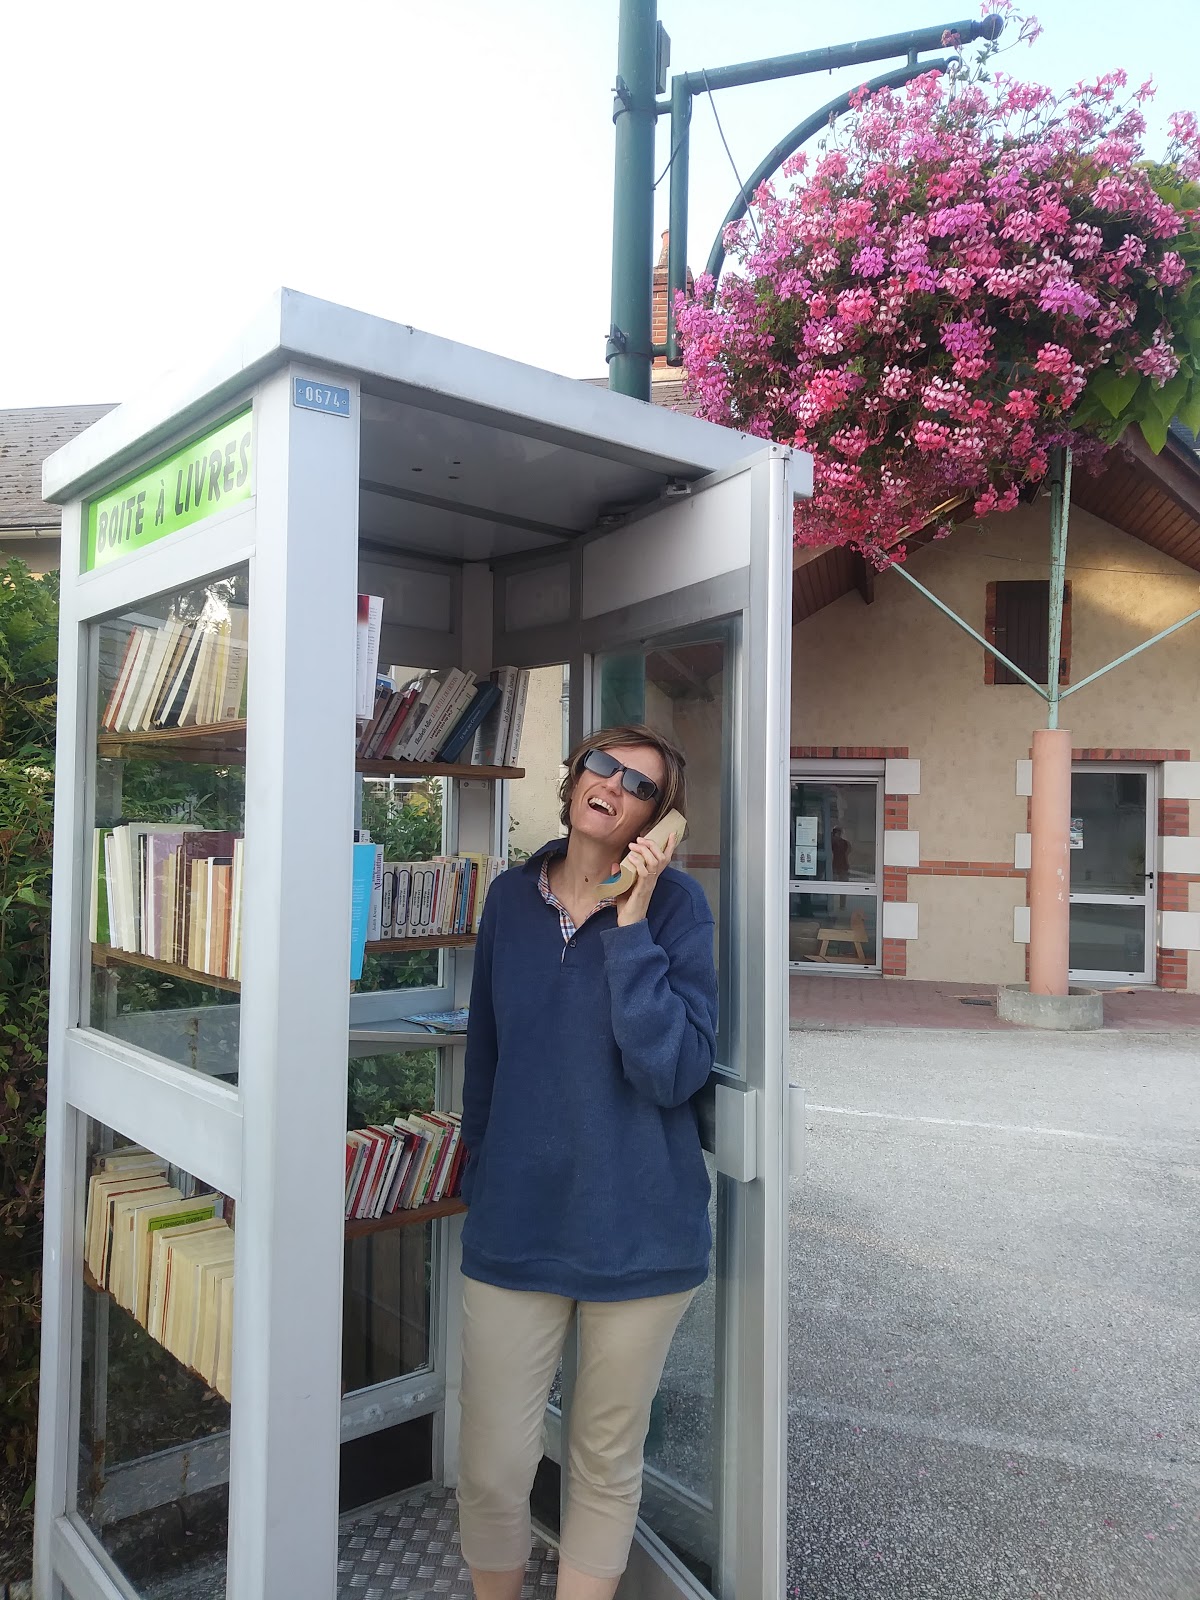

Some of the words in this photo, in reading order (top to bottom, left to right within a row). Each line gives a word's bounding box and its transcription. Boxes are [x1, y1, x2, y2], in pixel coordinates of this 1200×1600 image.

[305, 386, 340, 408] 0674
[98, 491, 146, 553] BOITE
[155, 479, 165, 527] À
[175, 431, 251, 516] LIVRES
[374, 853, 383, 891] Manhattan
